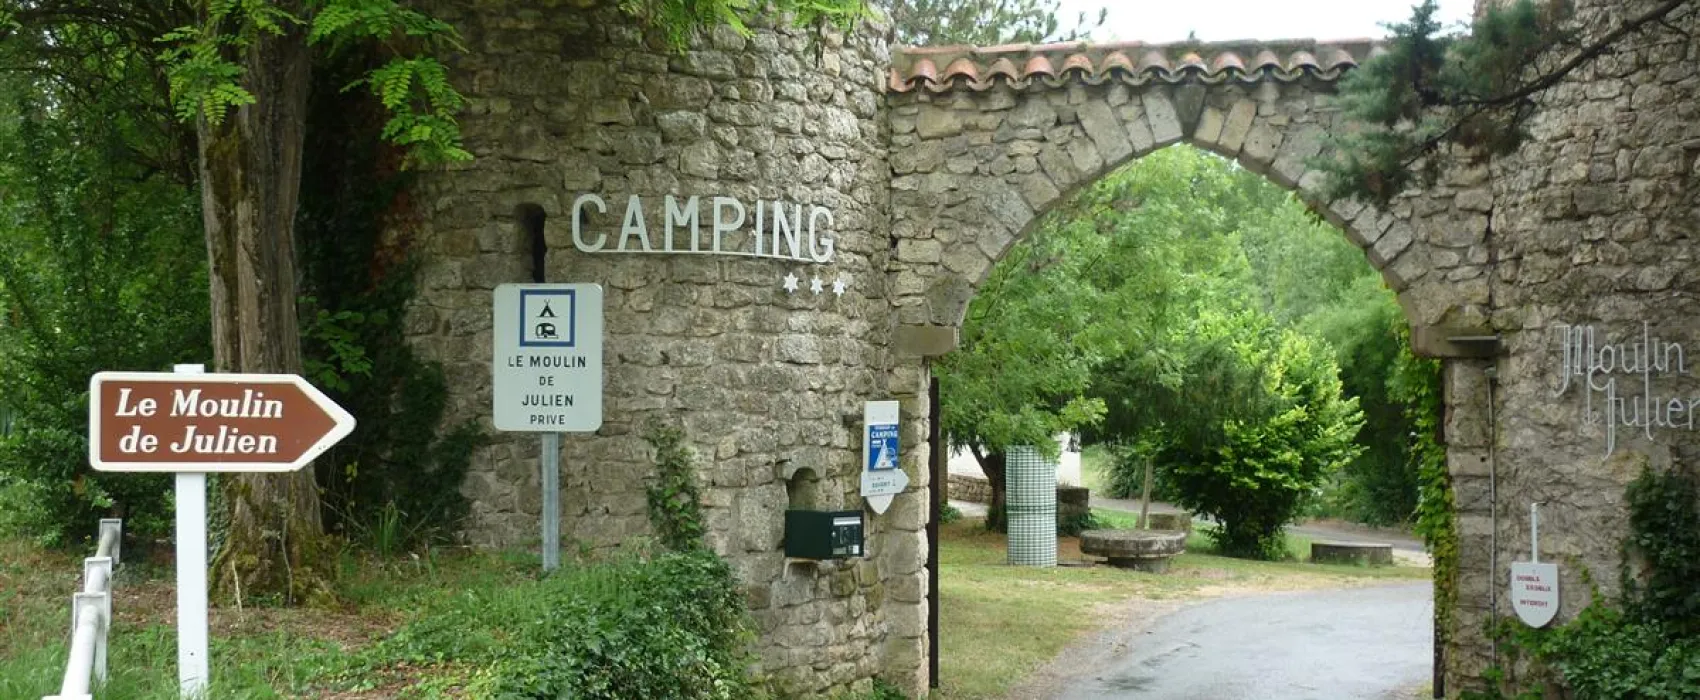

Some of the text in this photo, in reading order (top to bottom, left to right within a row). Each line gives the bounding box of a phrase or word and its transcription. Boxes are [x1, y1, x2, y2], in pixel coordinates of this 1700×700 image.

[571, 193, 834, 263] CAMPING
[508, 355, 586, 368] LE MOULIN
[1552, 320, 1689, 397] Moulin
[539, 376, 554, 386] DE
[115, 388, 283, 418] Le Moulin
[521, 394, 573, 406] JULIEN
[530, 414, 565, 425] PRIVE
[119, 425, 277, 453] de Julien
[870, 430, 898, 439] CAMPING
